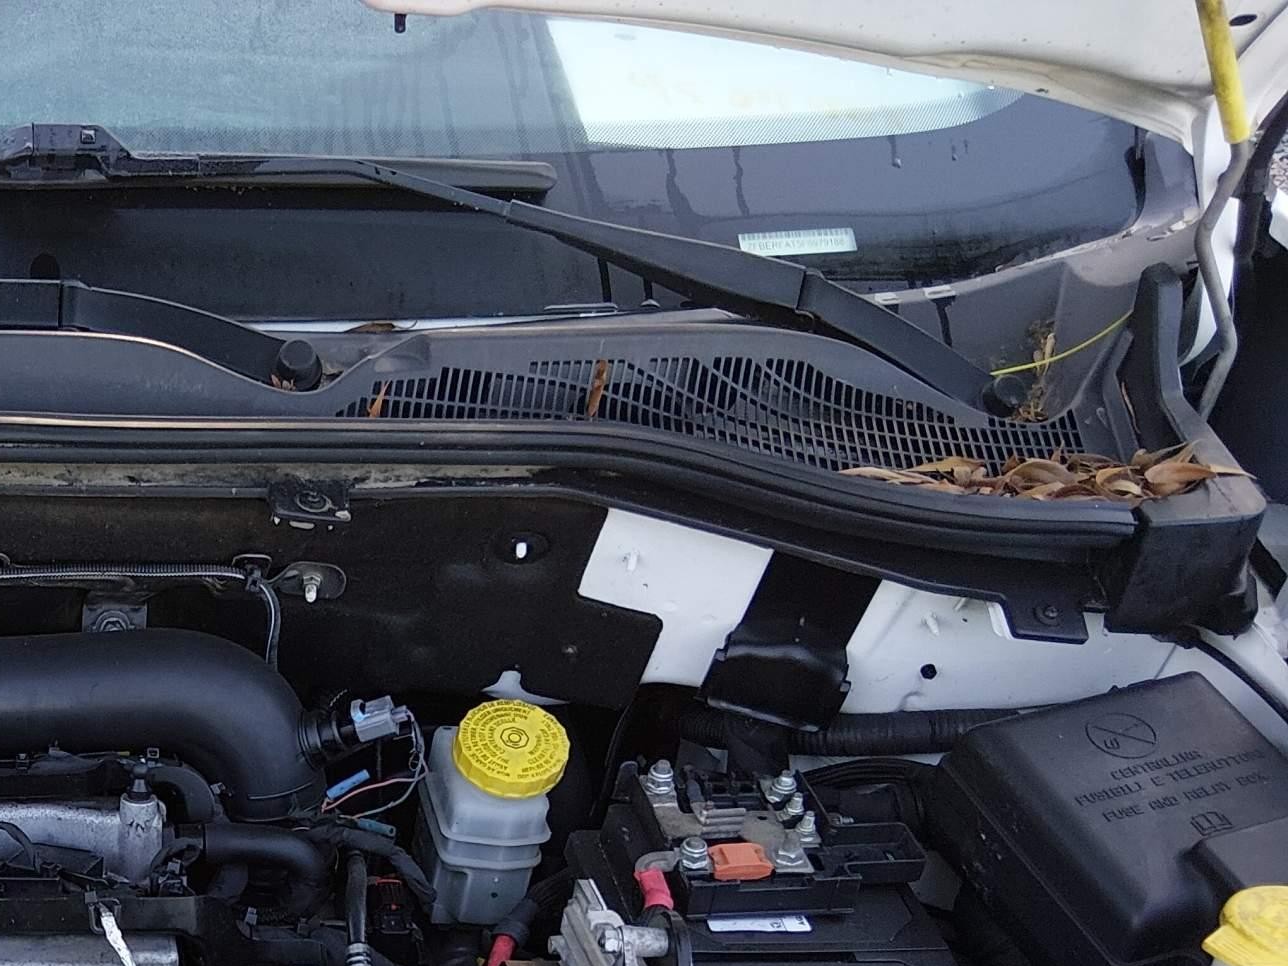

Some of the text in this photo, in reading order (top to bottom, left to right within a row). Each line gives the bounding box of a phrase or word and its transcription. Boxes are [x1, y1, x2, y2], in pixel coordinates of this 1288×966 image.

[1150, 775, 1164, 787] E
[1101, 802, 1145, 822] FUSE
[1148, 796, 1180, 811] AND
[1183, 781, 1232, 801] RELAY
